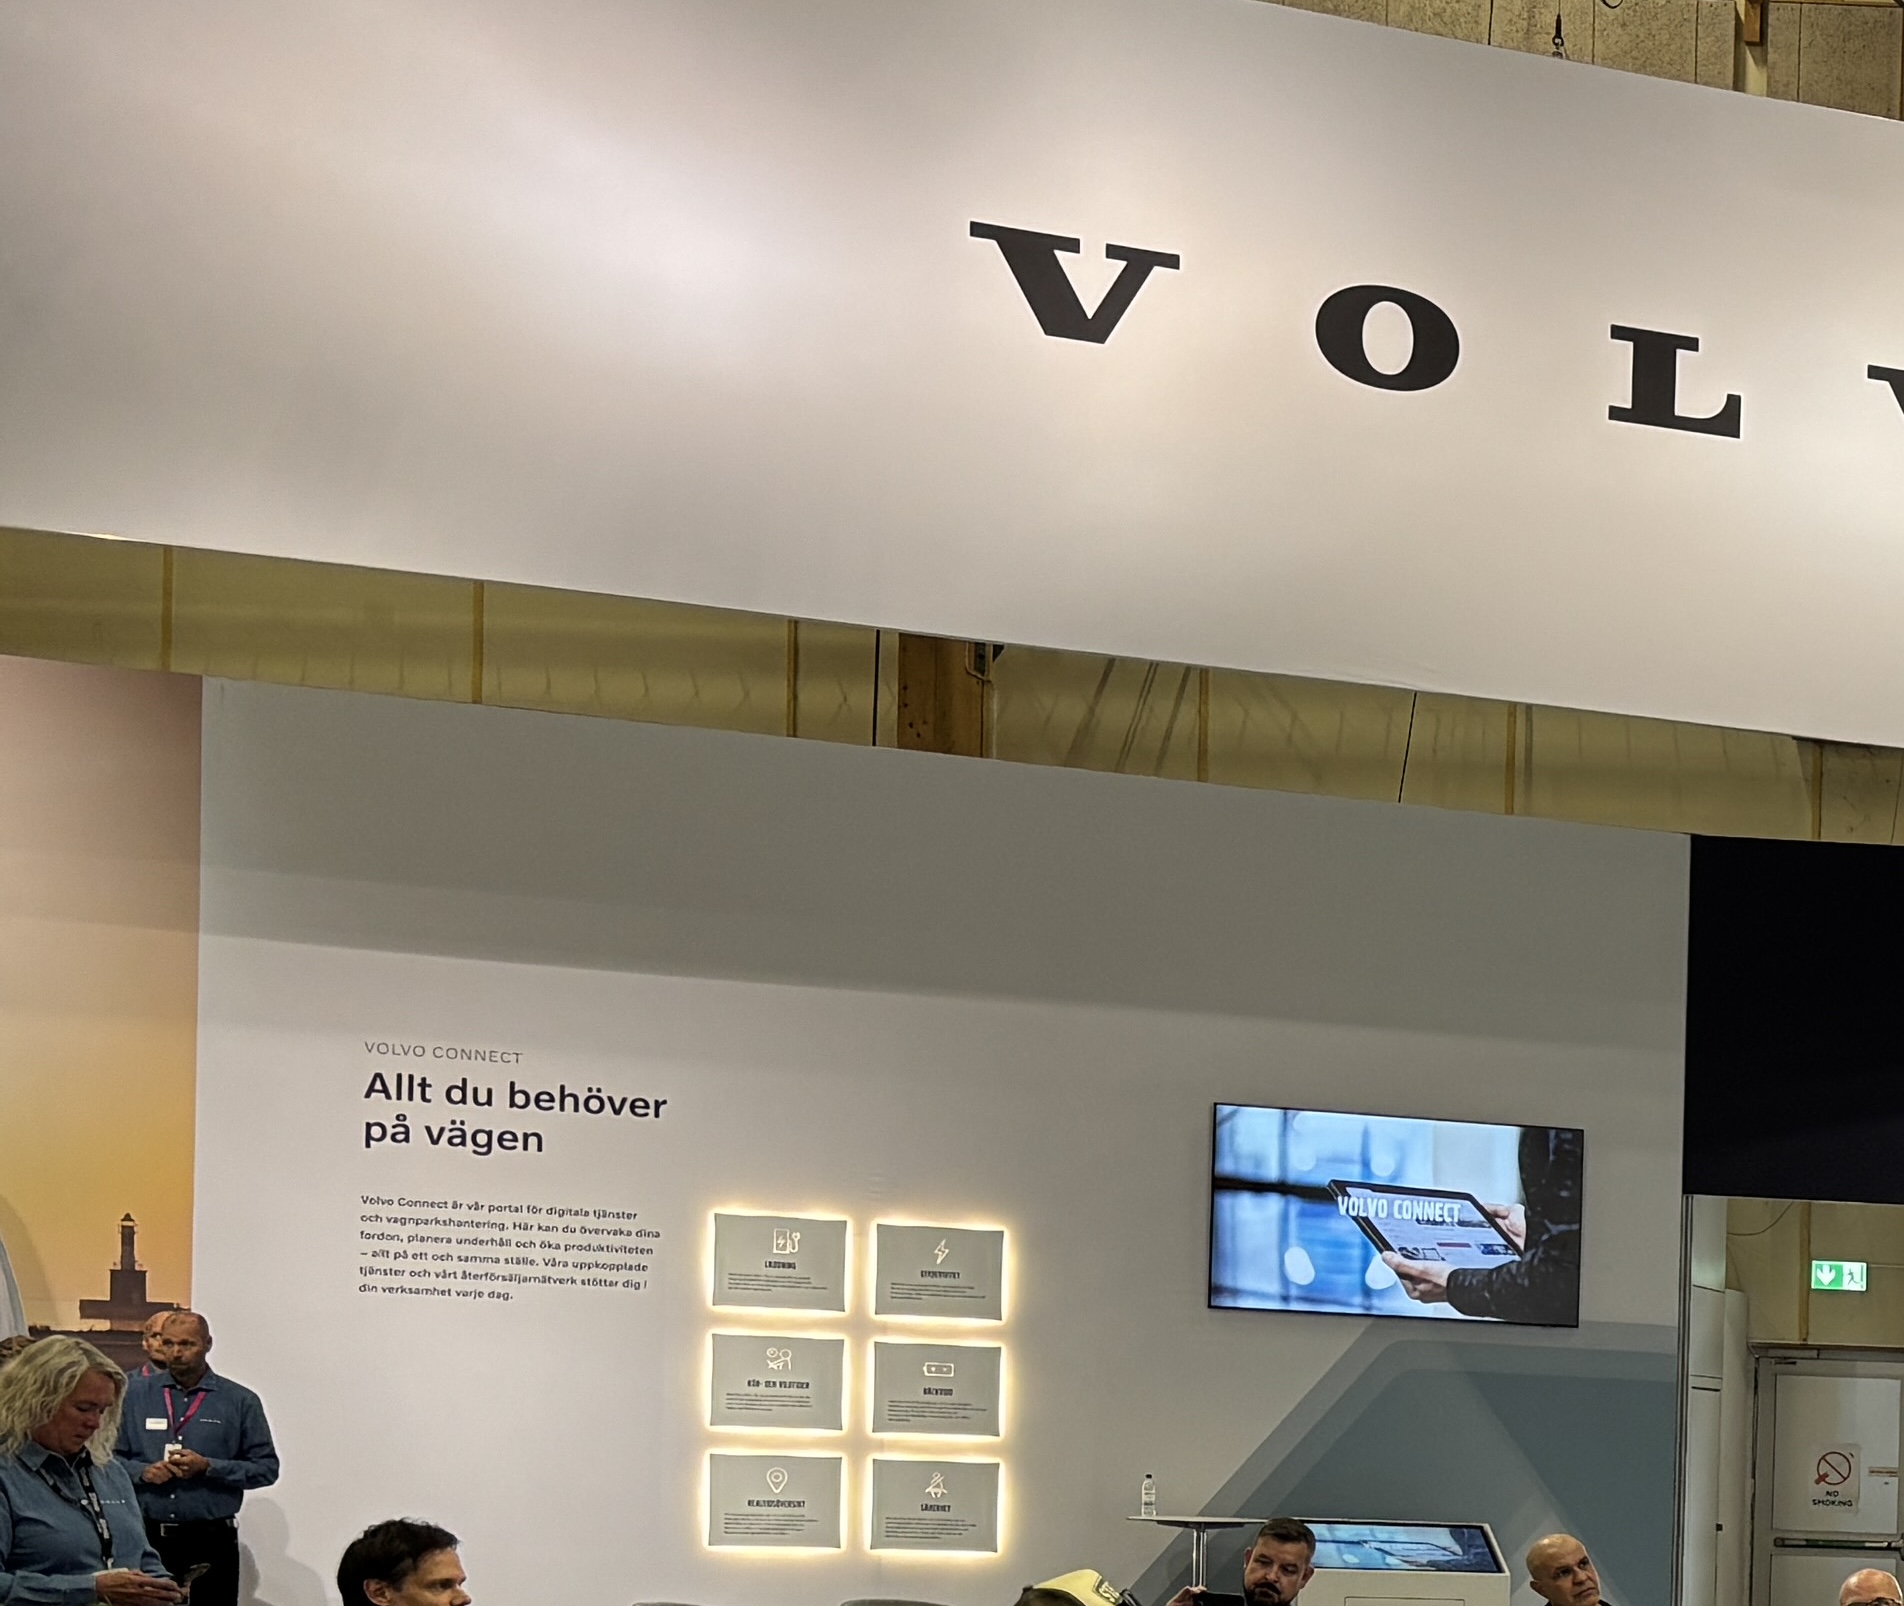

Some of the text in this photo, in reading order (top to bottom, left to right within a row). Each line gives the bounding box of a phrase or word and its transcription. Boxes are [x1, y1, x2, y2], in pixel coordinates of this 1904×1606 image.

[364, 1041, 524, 1064] VOLVO CONNECT
[363, 1071, 668, 1119] Allt du behöver
[364, 1113, 543, 1156] på vägen
[360, 1195, 395, 1206] Volvo
[397, 1197, 449, 1209] Connect
[1337, 1195, 1462, 1222] VOLVO CONNECT
[360, 1213, 383, 1224] och
[1825, 1490, 1840, 1498] NO
